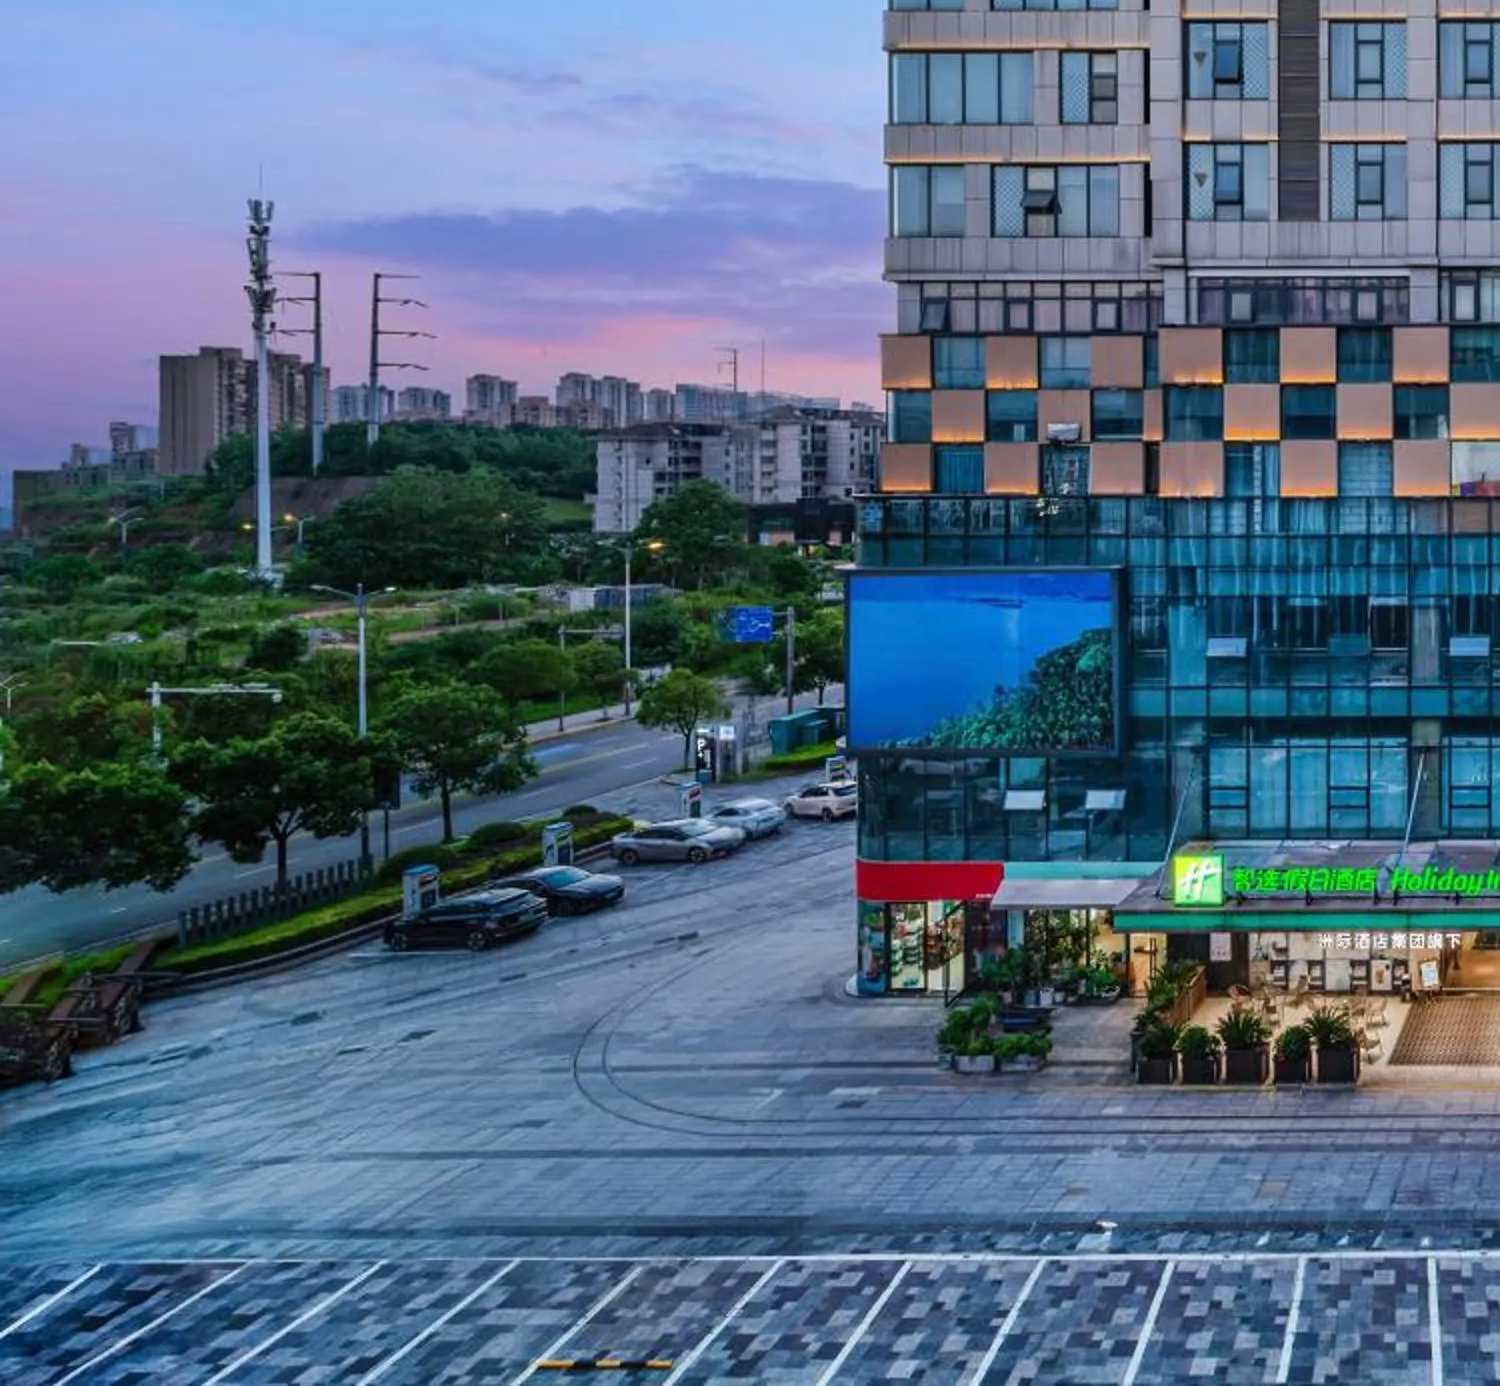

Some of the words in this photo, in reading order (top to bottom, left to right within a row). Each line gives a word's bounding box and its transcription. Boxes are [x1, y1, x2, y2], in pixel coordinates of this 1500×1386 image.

[1232, 866, 1378, 893] 智选假日酒店
[1391, 866, 1484, 897] Holiday
